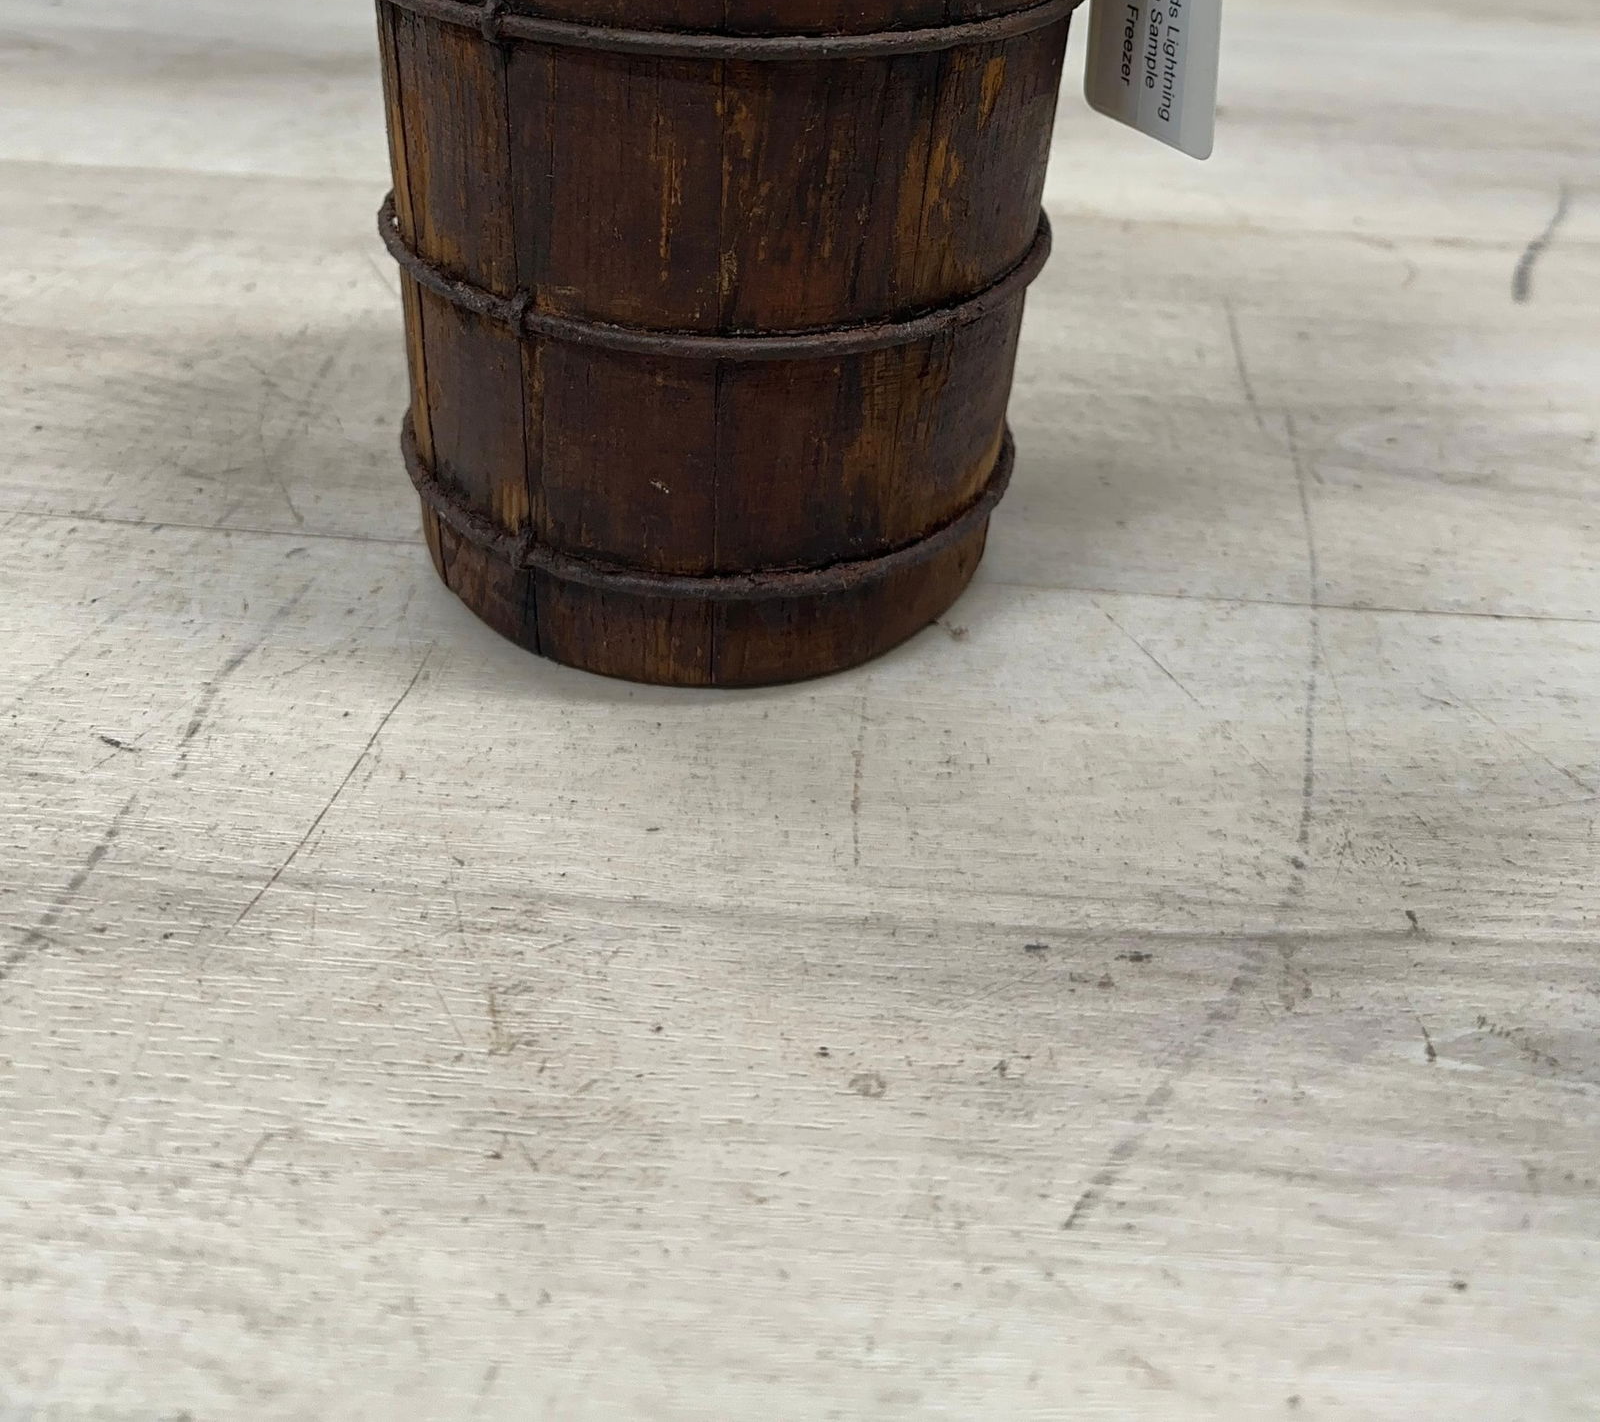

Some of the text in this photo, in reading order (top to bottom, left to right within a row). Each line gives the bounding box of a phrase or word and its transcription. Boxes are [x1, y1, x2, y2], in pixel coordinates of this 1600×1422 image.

[1120, 4, 1139, 87] Freezer
[1145, 8, 1163, 89] Sample
[1157, 25, 1180, 122] Lightning
